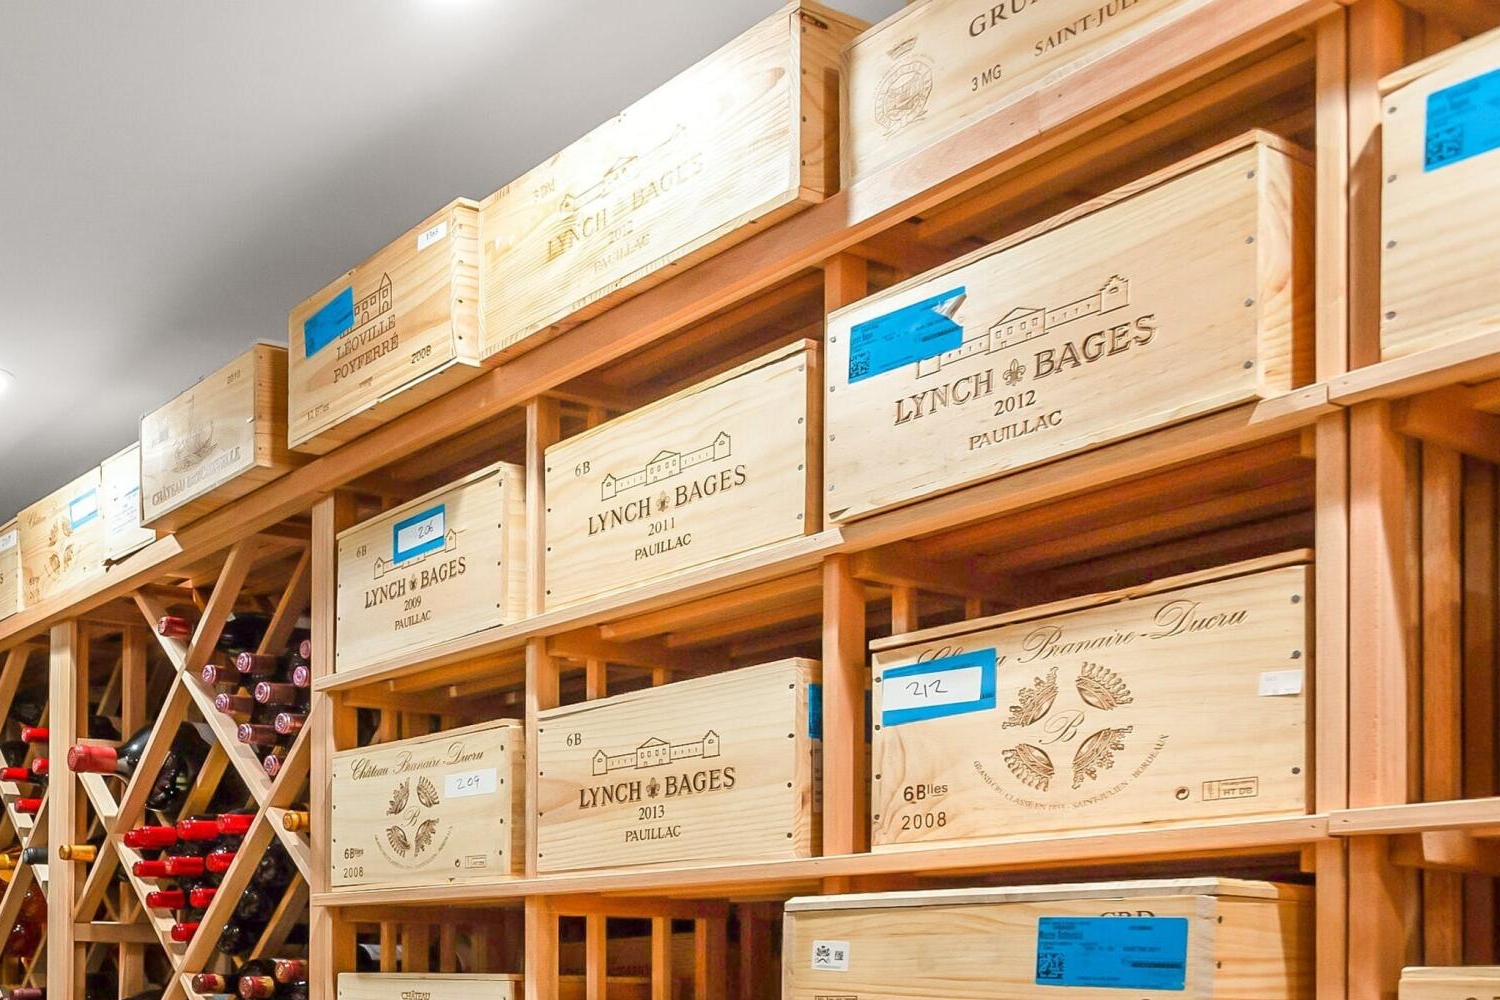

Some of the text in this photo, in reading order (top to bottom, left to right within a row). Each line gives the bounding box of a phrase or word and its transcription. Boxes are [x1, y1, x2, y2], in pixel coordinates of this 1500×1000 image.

[1034, 0, 1138, 58] SAINT-JUL
[971, 64, 1002, 92] 3 MG
[336, 314, 396, 361] LÉOVILLE
[333, 332, 399, 384] POYFERRÉ
[893, 367, 994, 426] LYNCH
[1033, 313, 1158, 380] BAGES
[994, 390, 1036, 416] 2012
[969, 410, 1063, 450] PAUILLAC
[574, 460, 591, 477] 6B
[587, 464, 746, 536] LYNCH BAGES
[648, 516, 675, 537] 2011
[634, 532, 692, 561] PAUILLAC
[364, 556, 467, 609] LYNCH BAGES
[404, 595, 422, 612] 2009
[394, 609, 432, 631] PAUILLAC
[905, 679, 949, 698] 212
[566, 733, 582, 748] 6B
[578, 766, 736, 810] LYNCH BAGES
[638, 804, 665, 822] 2013
[901, 811, 948, 831] 2008
[625, 825, 681, 843] PAUILLAC
[343, 867, 364, 879] 2008
